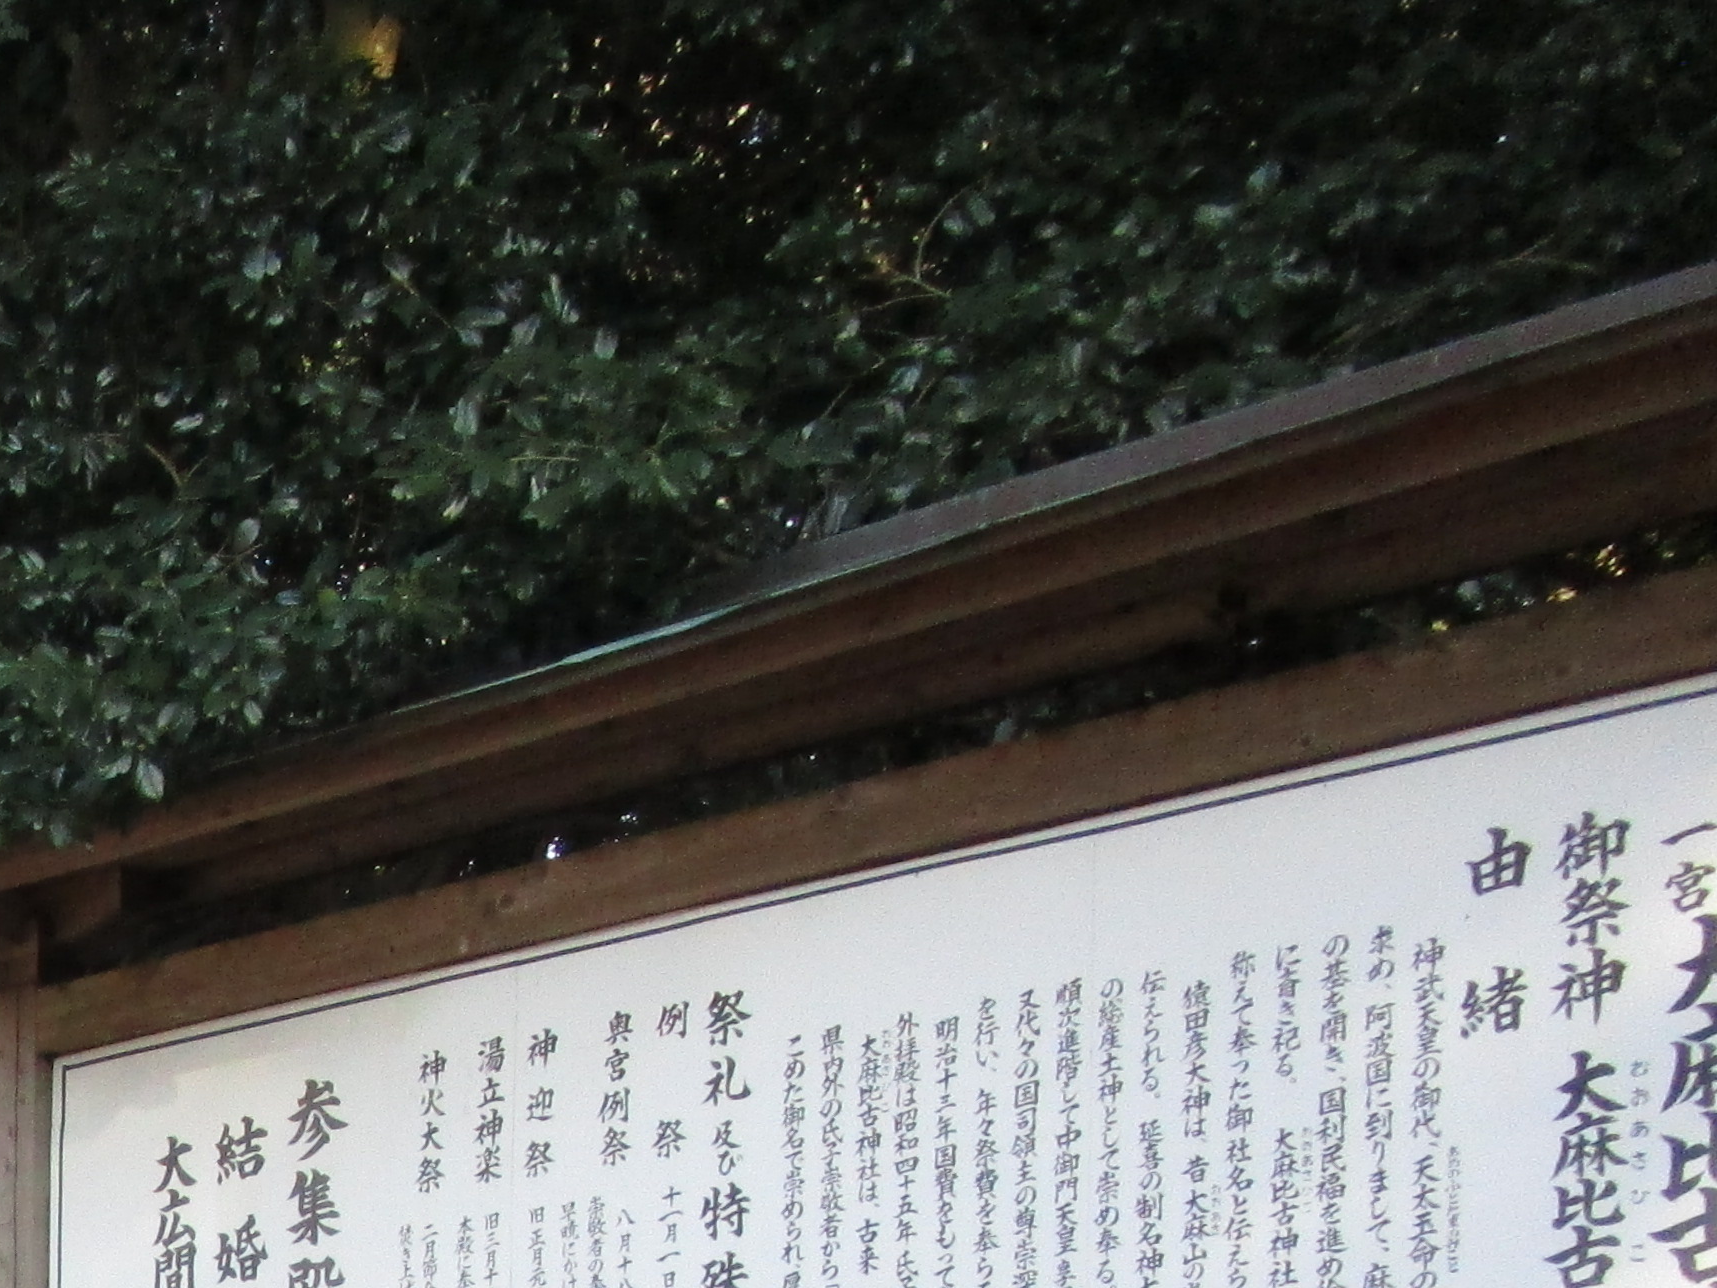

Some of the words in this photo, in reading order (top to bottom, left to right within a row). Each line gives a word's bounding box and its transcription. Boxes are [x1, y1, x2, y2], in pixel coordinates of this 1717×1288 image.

[1460, 827, 1532, 1038] 由緒
[1552, 811, 1631, 1025] 御祭神
[416, 1049, 447, 1194] 神火大祭
[474, 1035, 506, 1184] 湯立神楽
[523, 1027, 559, 1179] 神迎祭
[597, 1010, 634, 1166] 奥宮例祭
[651, 1000, 690, 1159] 例祭
